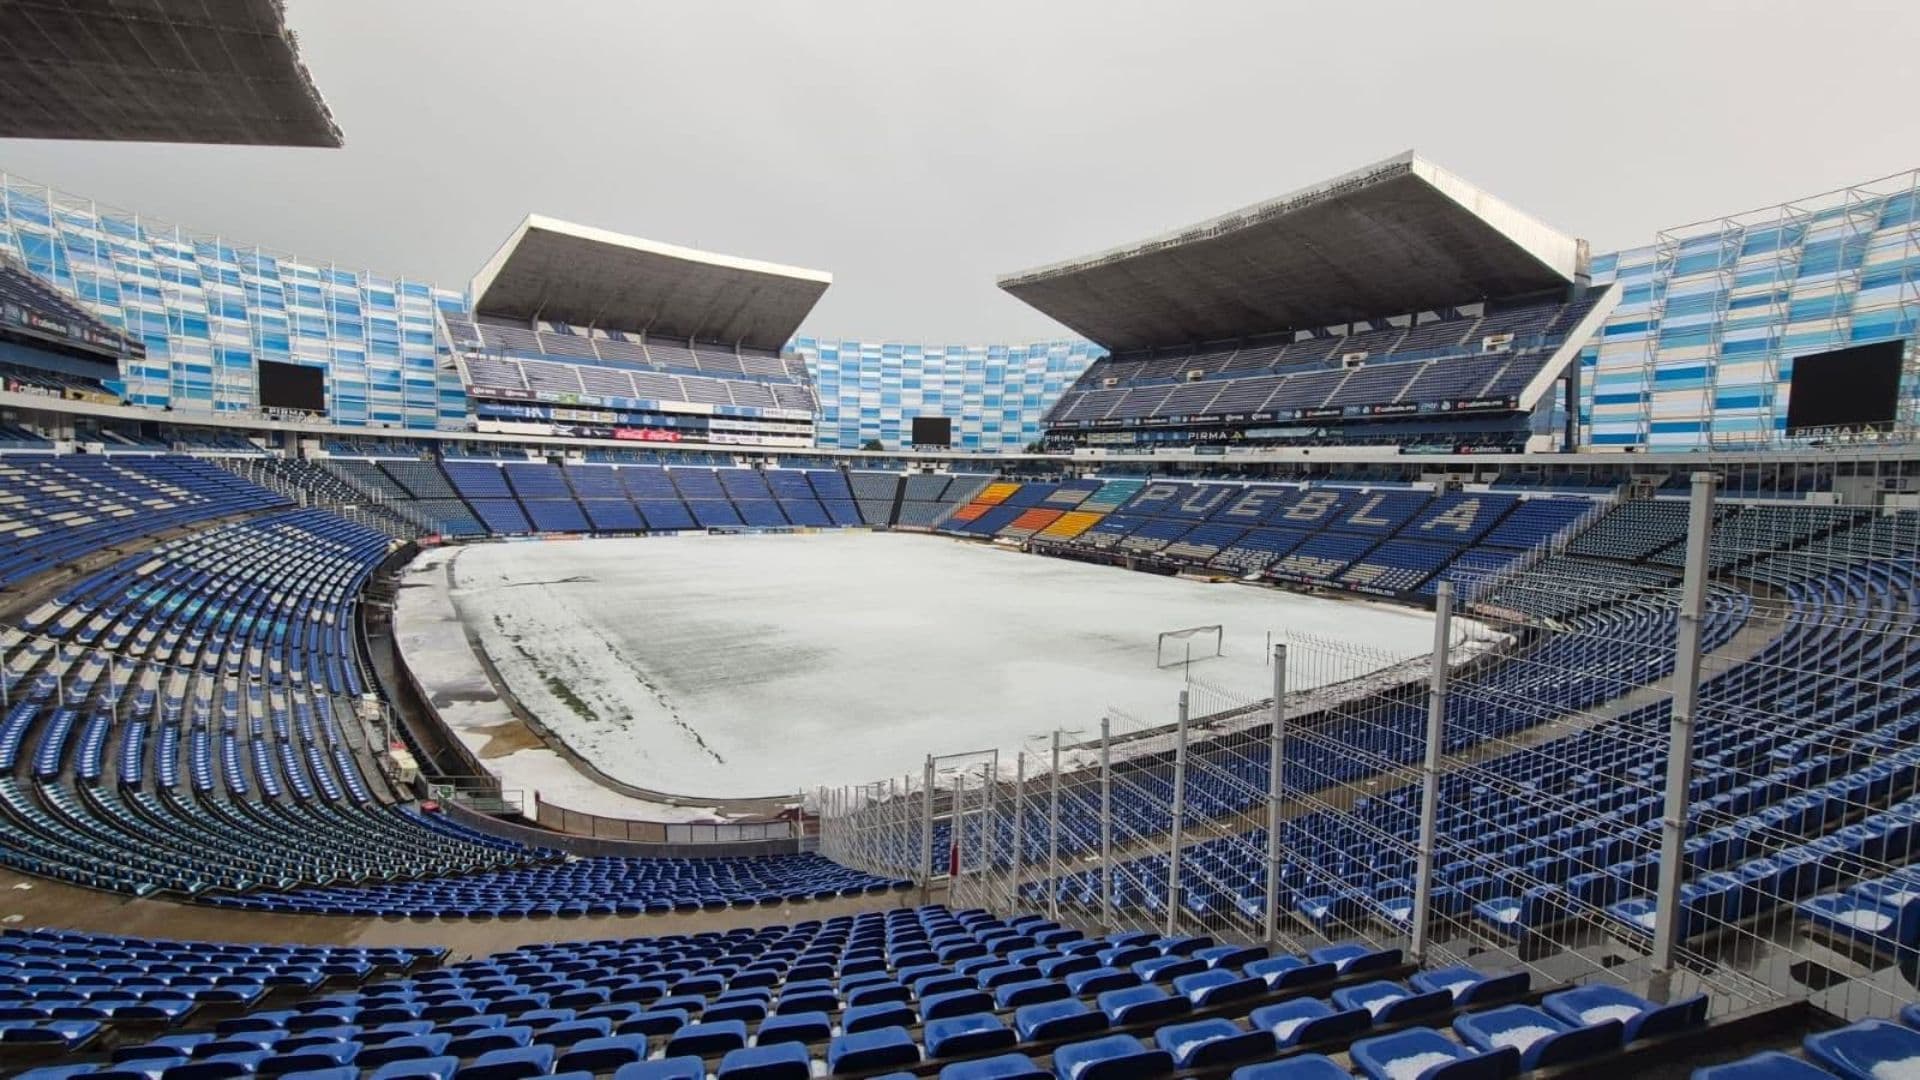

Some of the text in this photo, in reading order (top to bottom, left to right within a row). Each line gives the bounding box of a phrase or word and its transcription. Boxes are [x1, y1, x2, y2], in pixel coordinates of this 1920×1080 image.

[1188, 431, 1227, 440] PIRMA
[1794, 426, 1853, 438] PIRMA
[1130, 483, 1481, 533] PUEBLA
